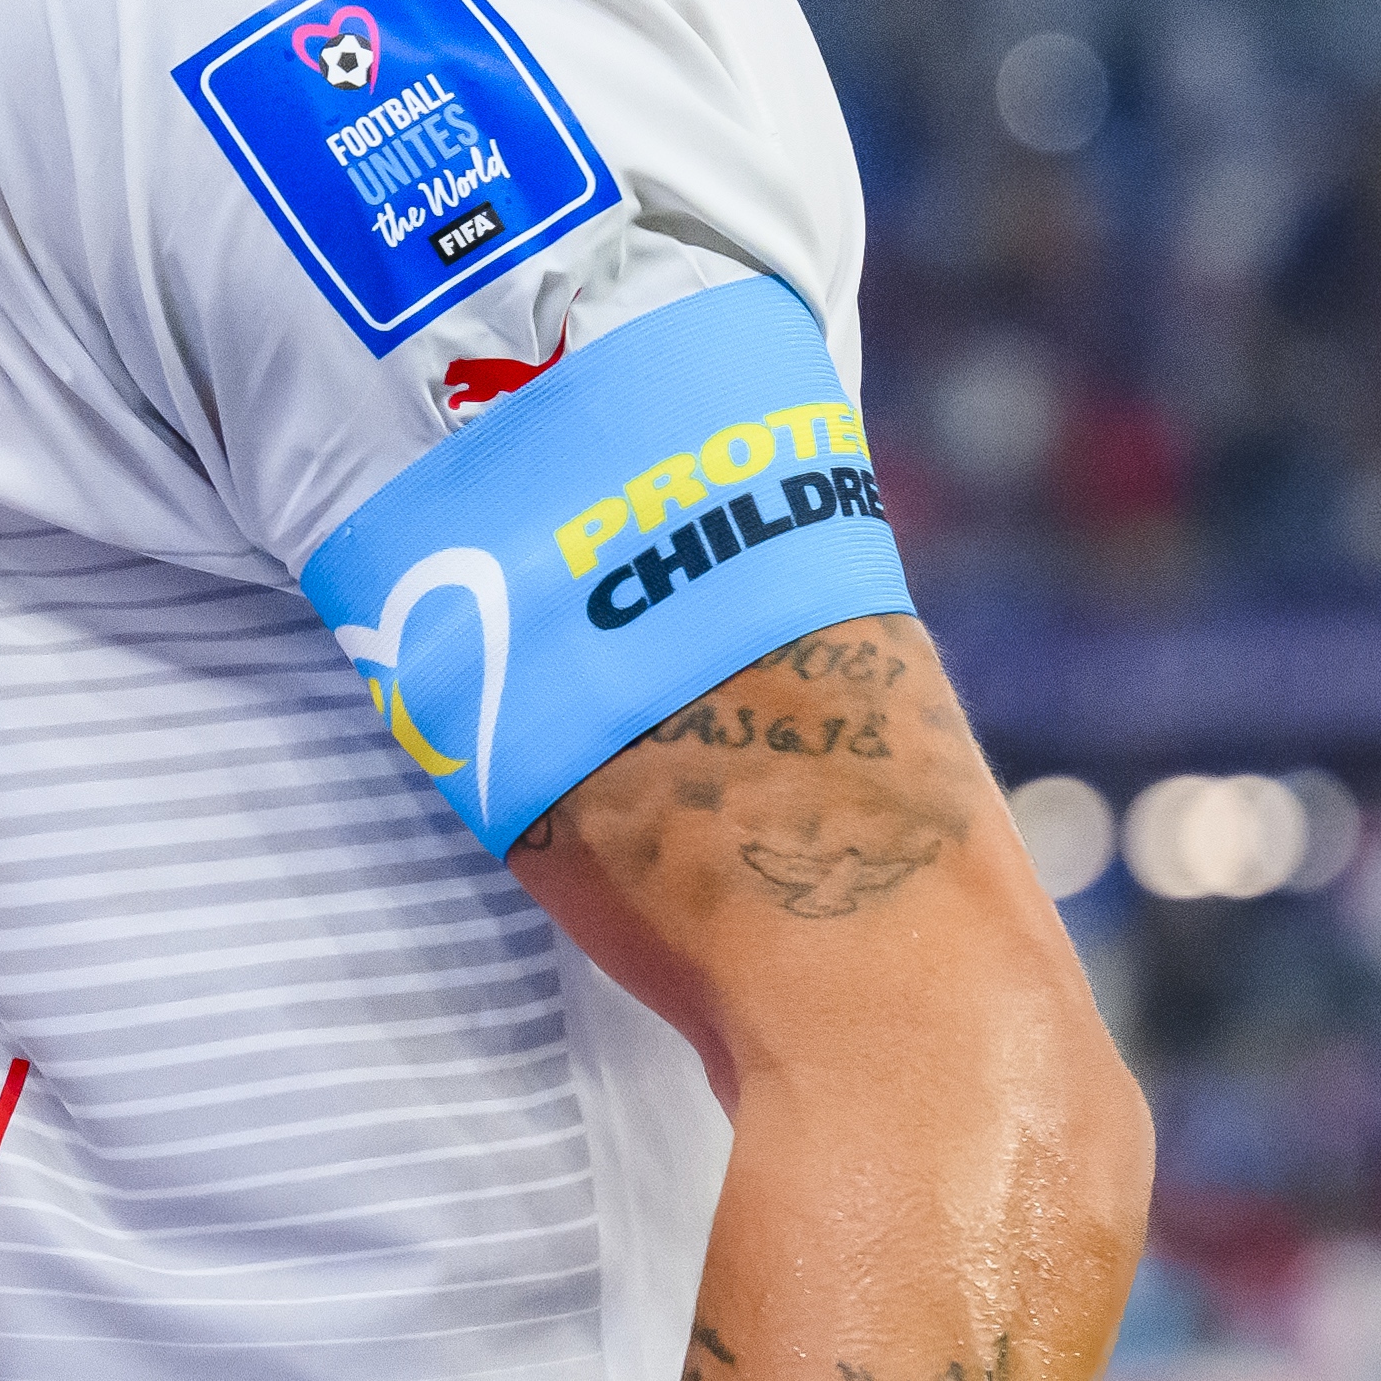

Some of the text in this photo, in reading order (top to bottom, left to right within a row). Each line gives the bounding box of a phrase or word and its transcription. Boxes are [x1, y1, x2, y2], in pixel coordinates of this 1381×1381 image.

[326, 73, 455, 166] FOOTBALL
[347, 103, 479, 206] UNITES
[371, 138, 511, 248] the World
[438, 212, 496, 257] FIFA
